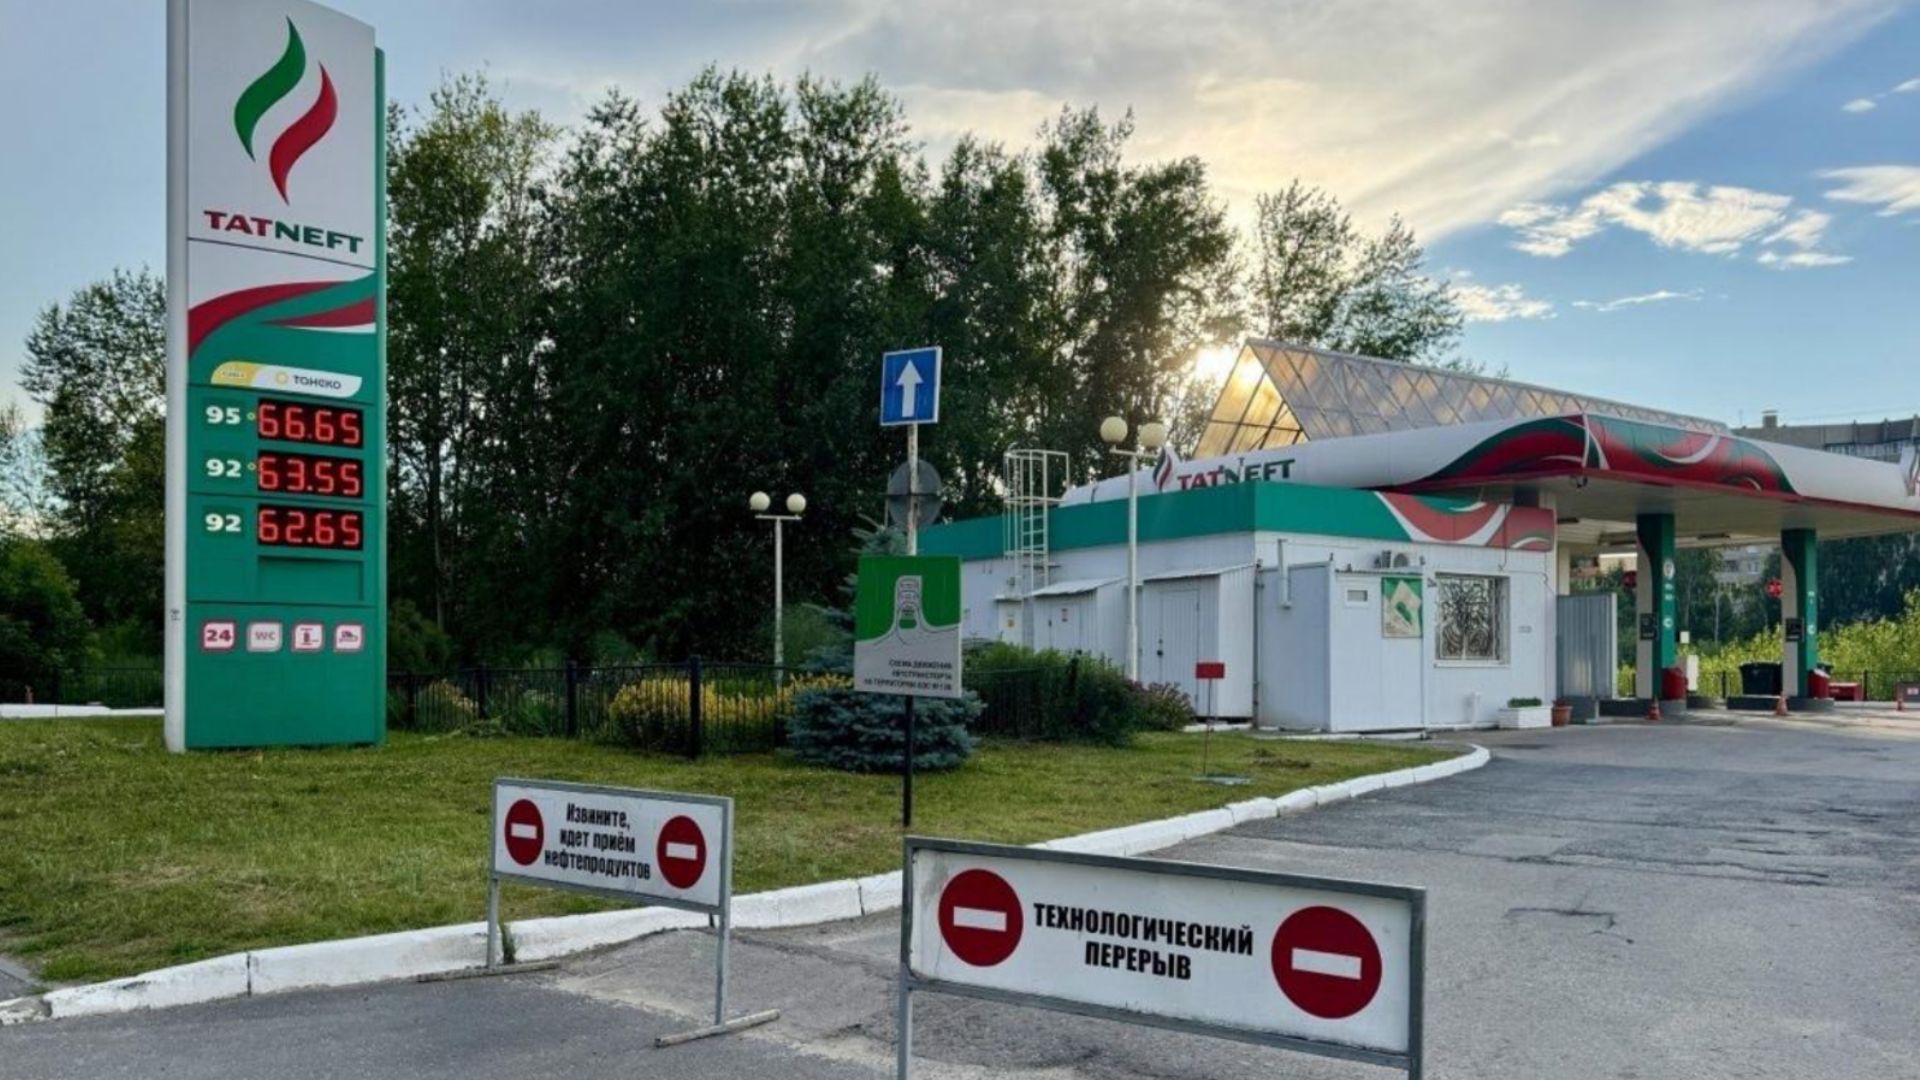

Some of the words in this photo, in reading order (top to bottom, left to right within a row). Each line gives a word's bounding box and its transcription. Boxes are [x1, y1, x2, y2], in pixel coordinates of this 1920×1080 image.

[203, 210, 364, 254] TATNEFT
[205, 405, 241, 425] 95
[258, 404, 360, 444] 66.65
[205, 458, 242, 478] 92
[258, 456, 360, 496] 63.55
[1177, 458, 1296, 490] TATNEFT
[204, 513, 242, 532] 92
[258, 509, 360, 546] 62.65
[206, 629, 232, 642] 24
[254, 630, 276, 641] WC
[566, 803, 630, 830] Извините,
[560, 829, 589, 846] идет
[593, 832, 635, 853] приём
[544, 849, 651, 880] нефтепродуктов
[1033, 902, 1254, 956] ТЕХНОЛОГИЧЕСКИЙ
[1085, 941, 1192, 980] ПЕРЕРЫВ
